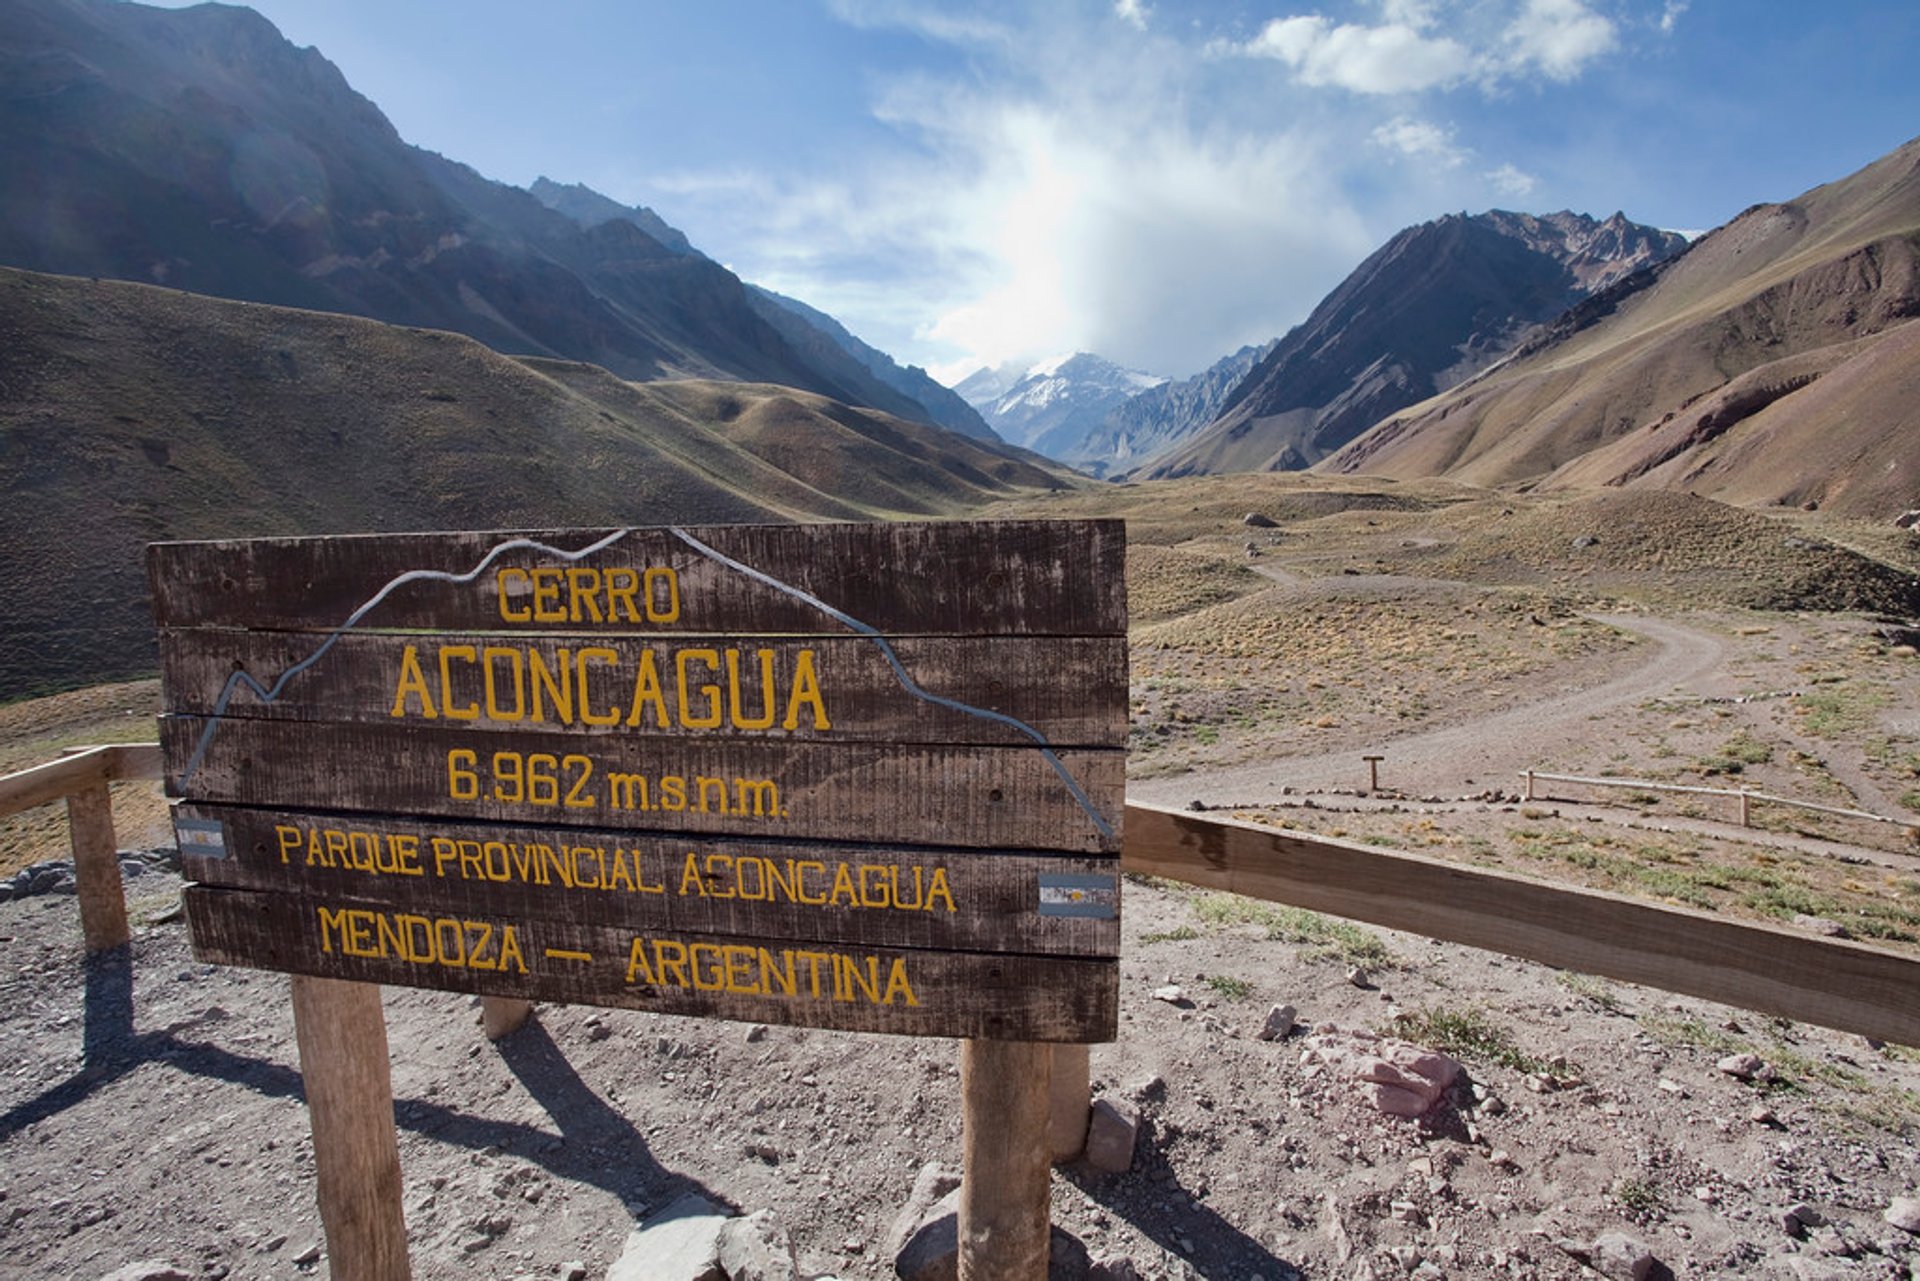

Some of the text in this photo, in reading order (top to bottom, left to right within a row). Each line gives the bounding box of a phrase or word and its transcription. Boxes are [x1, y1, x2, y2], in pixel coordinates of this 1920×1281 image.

[497, 566, 680, 624] CERRO
[390, 644, 831, 731] ACONCAGUA
[447, 748, 789, 819] 6.962 m.s.n.m.
[275, 825, 958, 913] PARQUE PROVINCIAL ACONCAGUA
[317, 907, 529, 974] MENDOZA
[625, 937, 921, 1007] ARGENTINA
